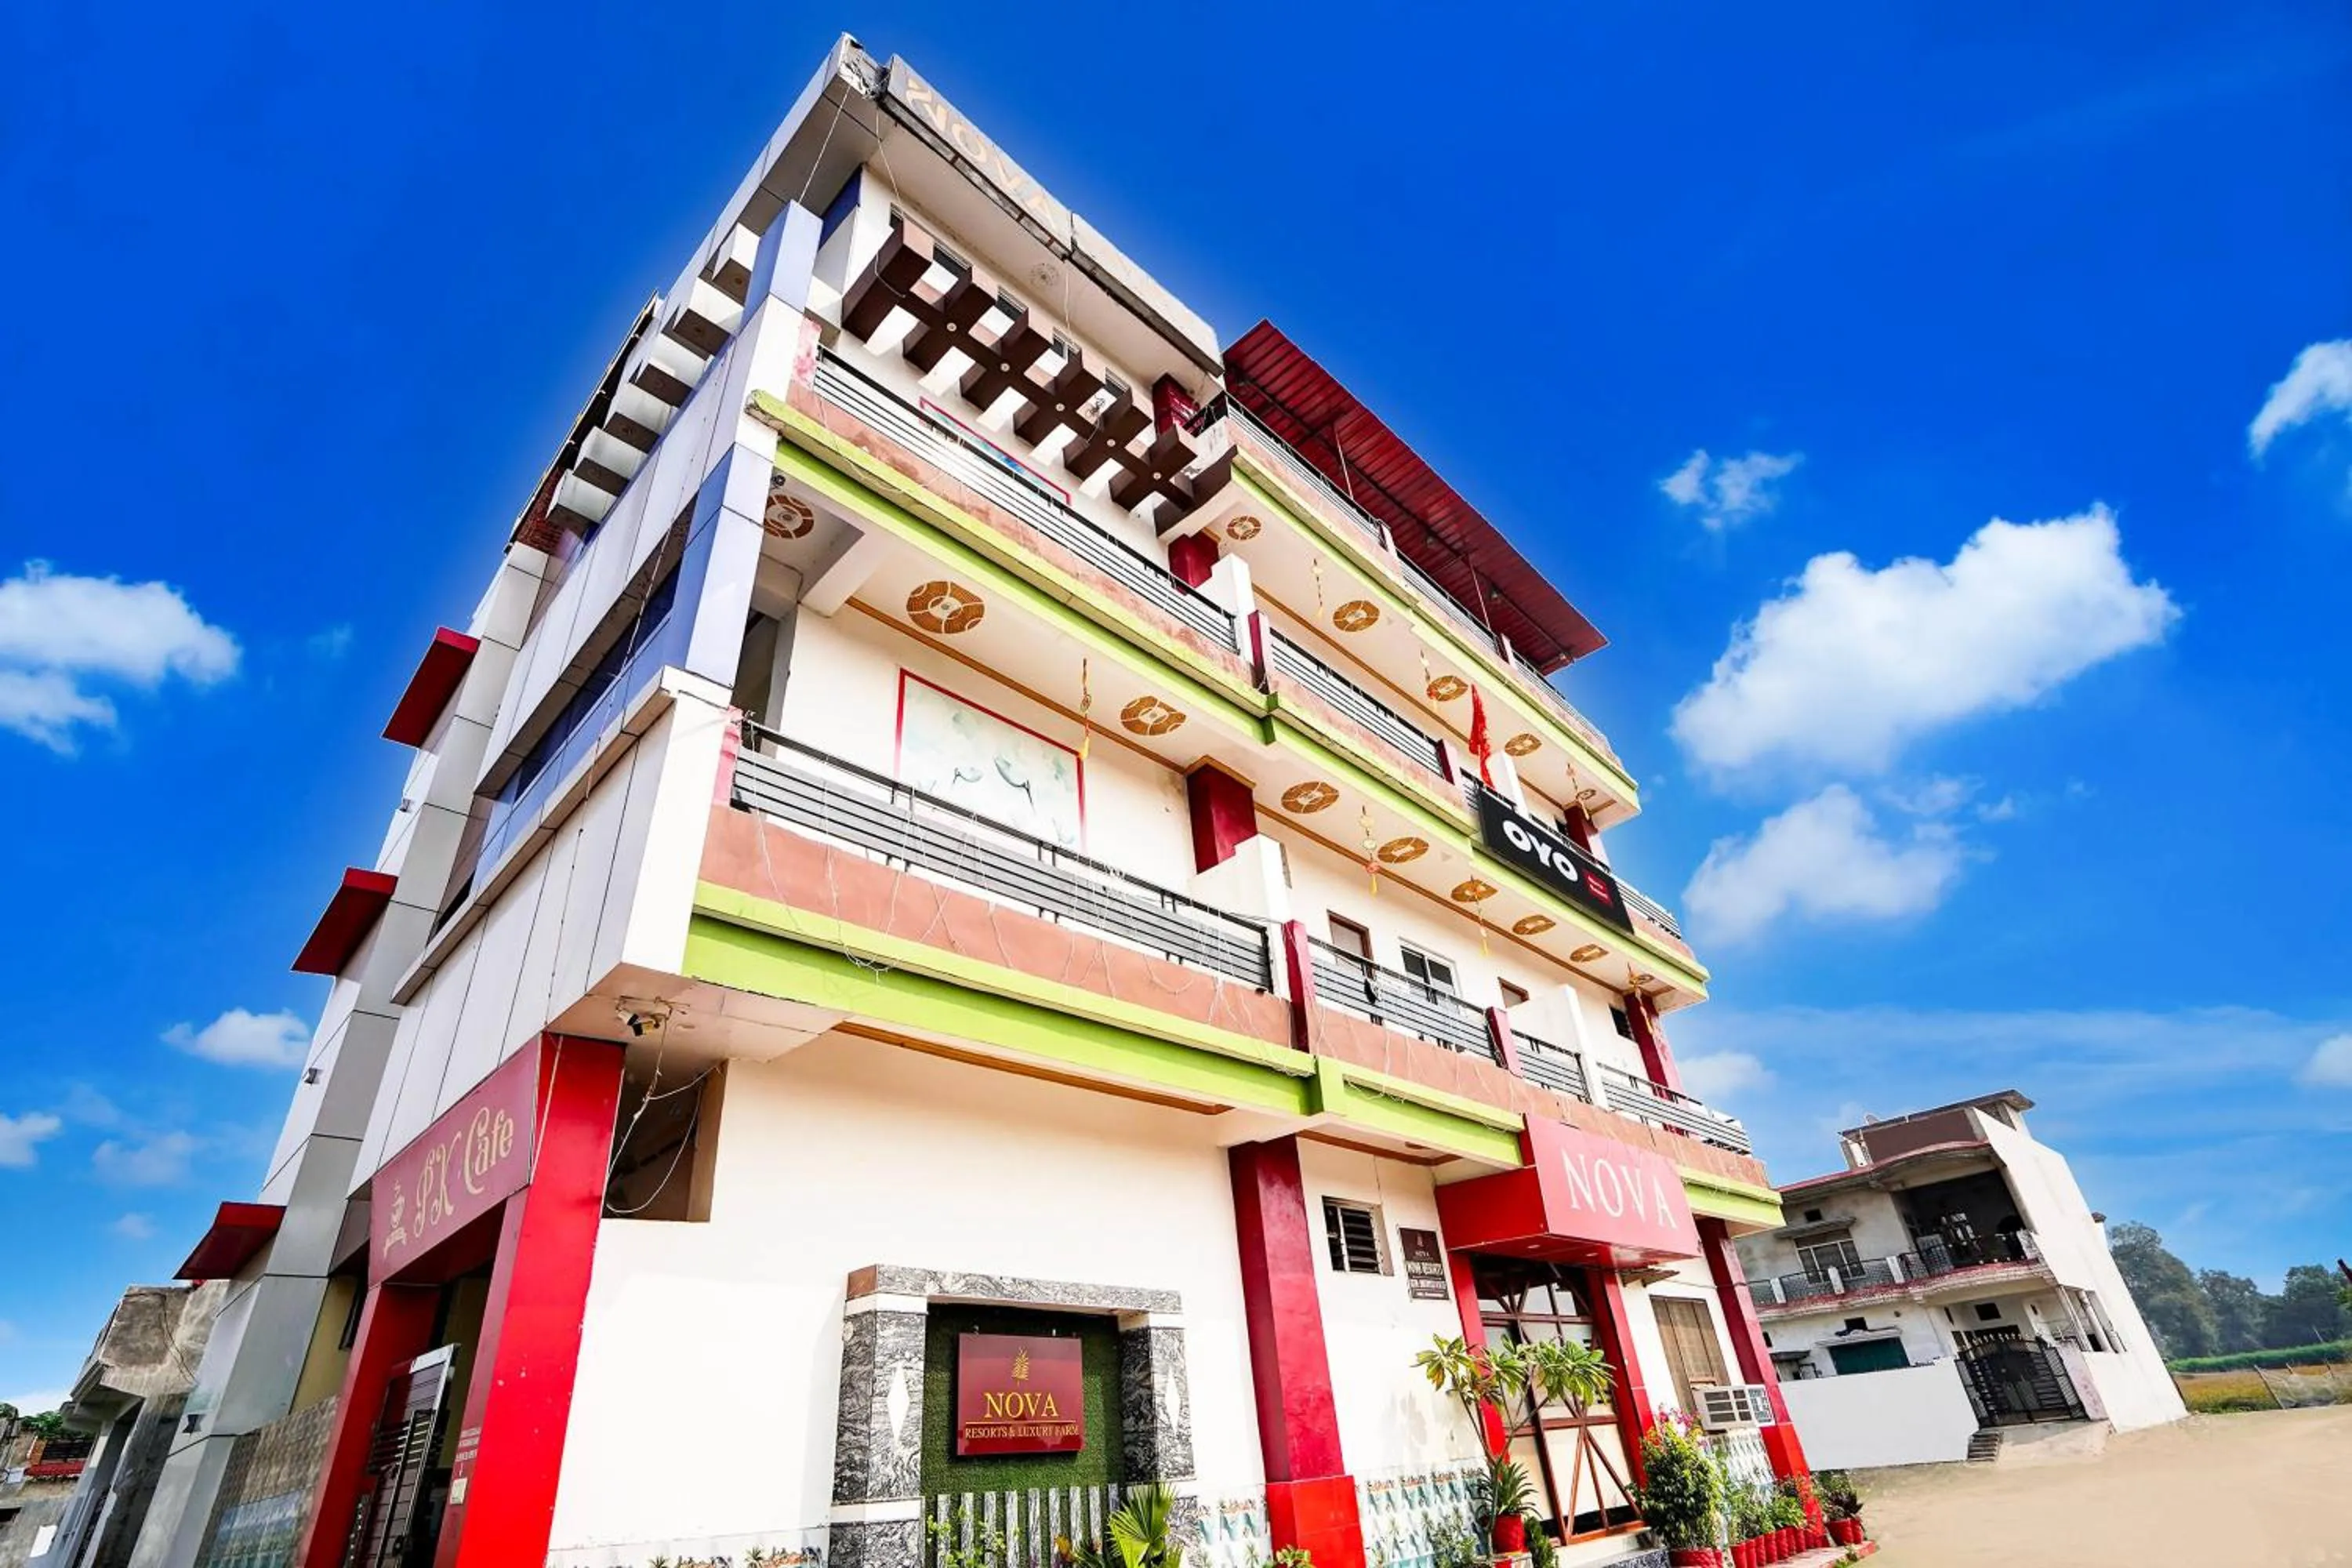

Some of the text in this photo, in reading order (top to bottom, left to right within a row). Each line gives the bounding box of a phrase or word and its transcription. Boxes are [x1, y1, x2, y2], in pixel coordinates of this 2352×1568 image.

[1502, 820, 1578, 882] OYO
[464, 1106, 514, 1195] Cafe
[1562, 1149, 1677, 1229] NOVA
[965, 1427, 1007, 1439] RESORTS
[1008, 1427, 1015, 1437] &
[1018, 1426, 1053, 1437] LUXURY
[984, 1392, 1058, 1417] NOVA
